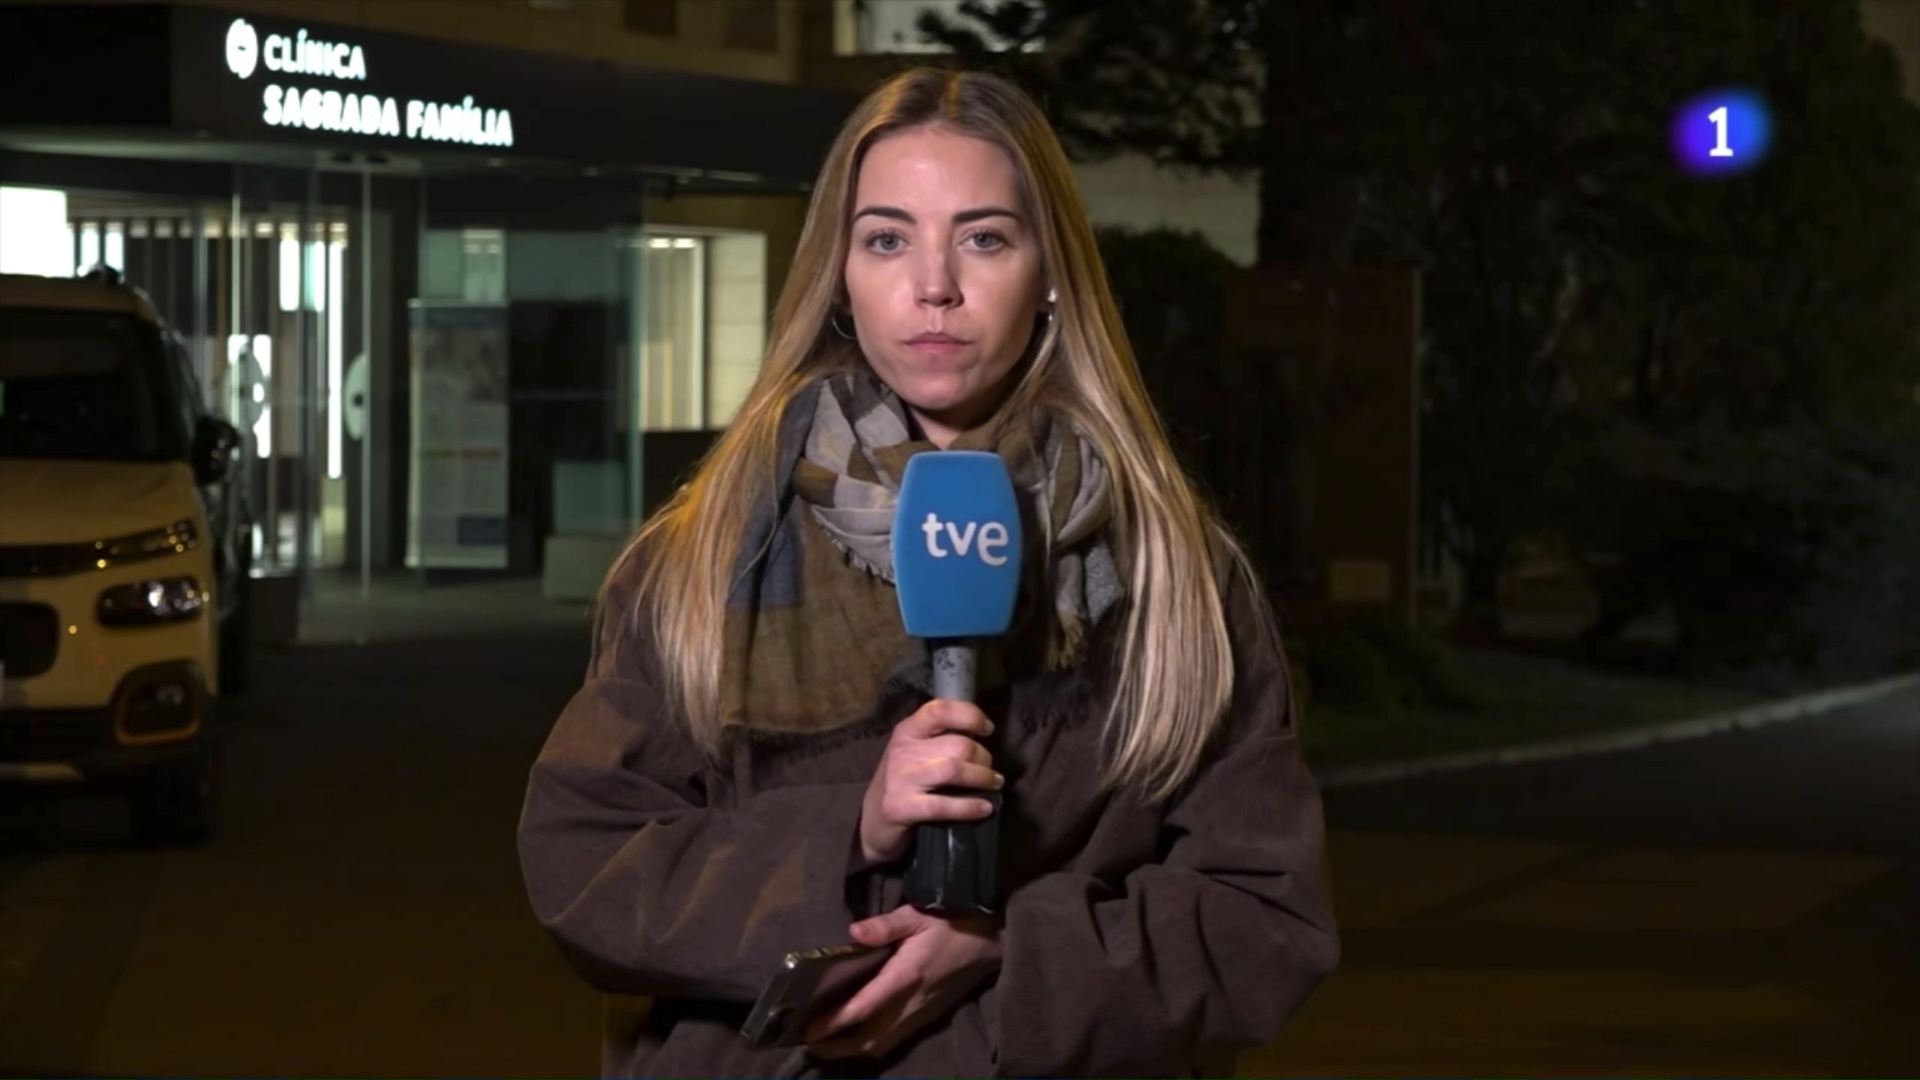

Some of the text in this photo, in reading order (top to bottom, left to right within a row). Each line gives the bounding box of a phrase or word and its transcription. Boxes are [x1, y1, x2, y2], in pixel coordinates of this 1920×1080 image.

[264, 29, 367, 80] CLÍNICA
[263, 85, 513, 147] SAGRADA FAMÍLIA
[921, 512, 1010, 567] tve
